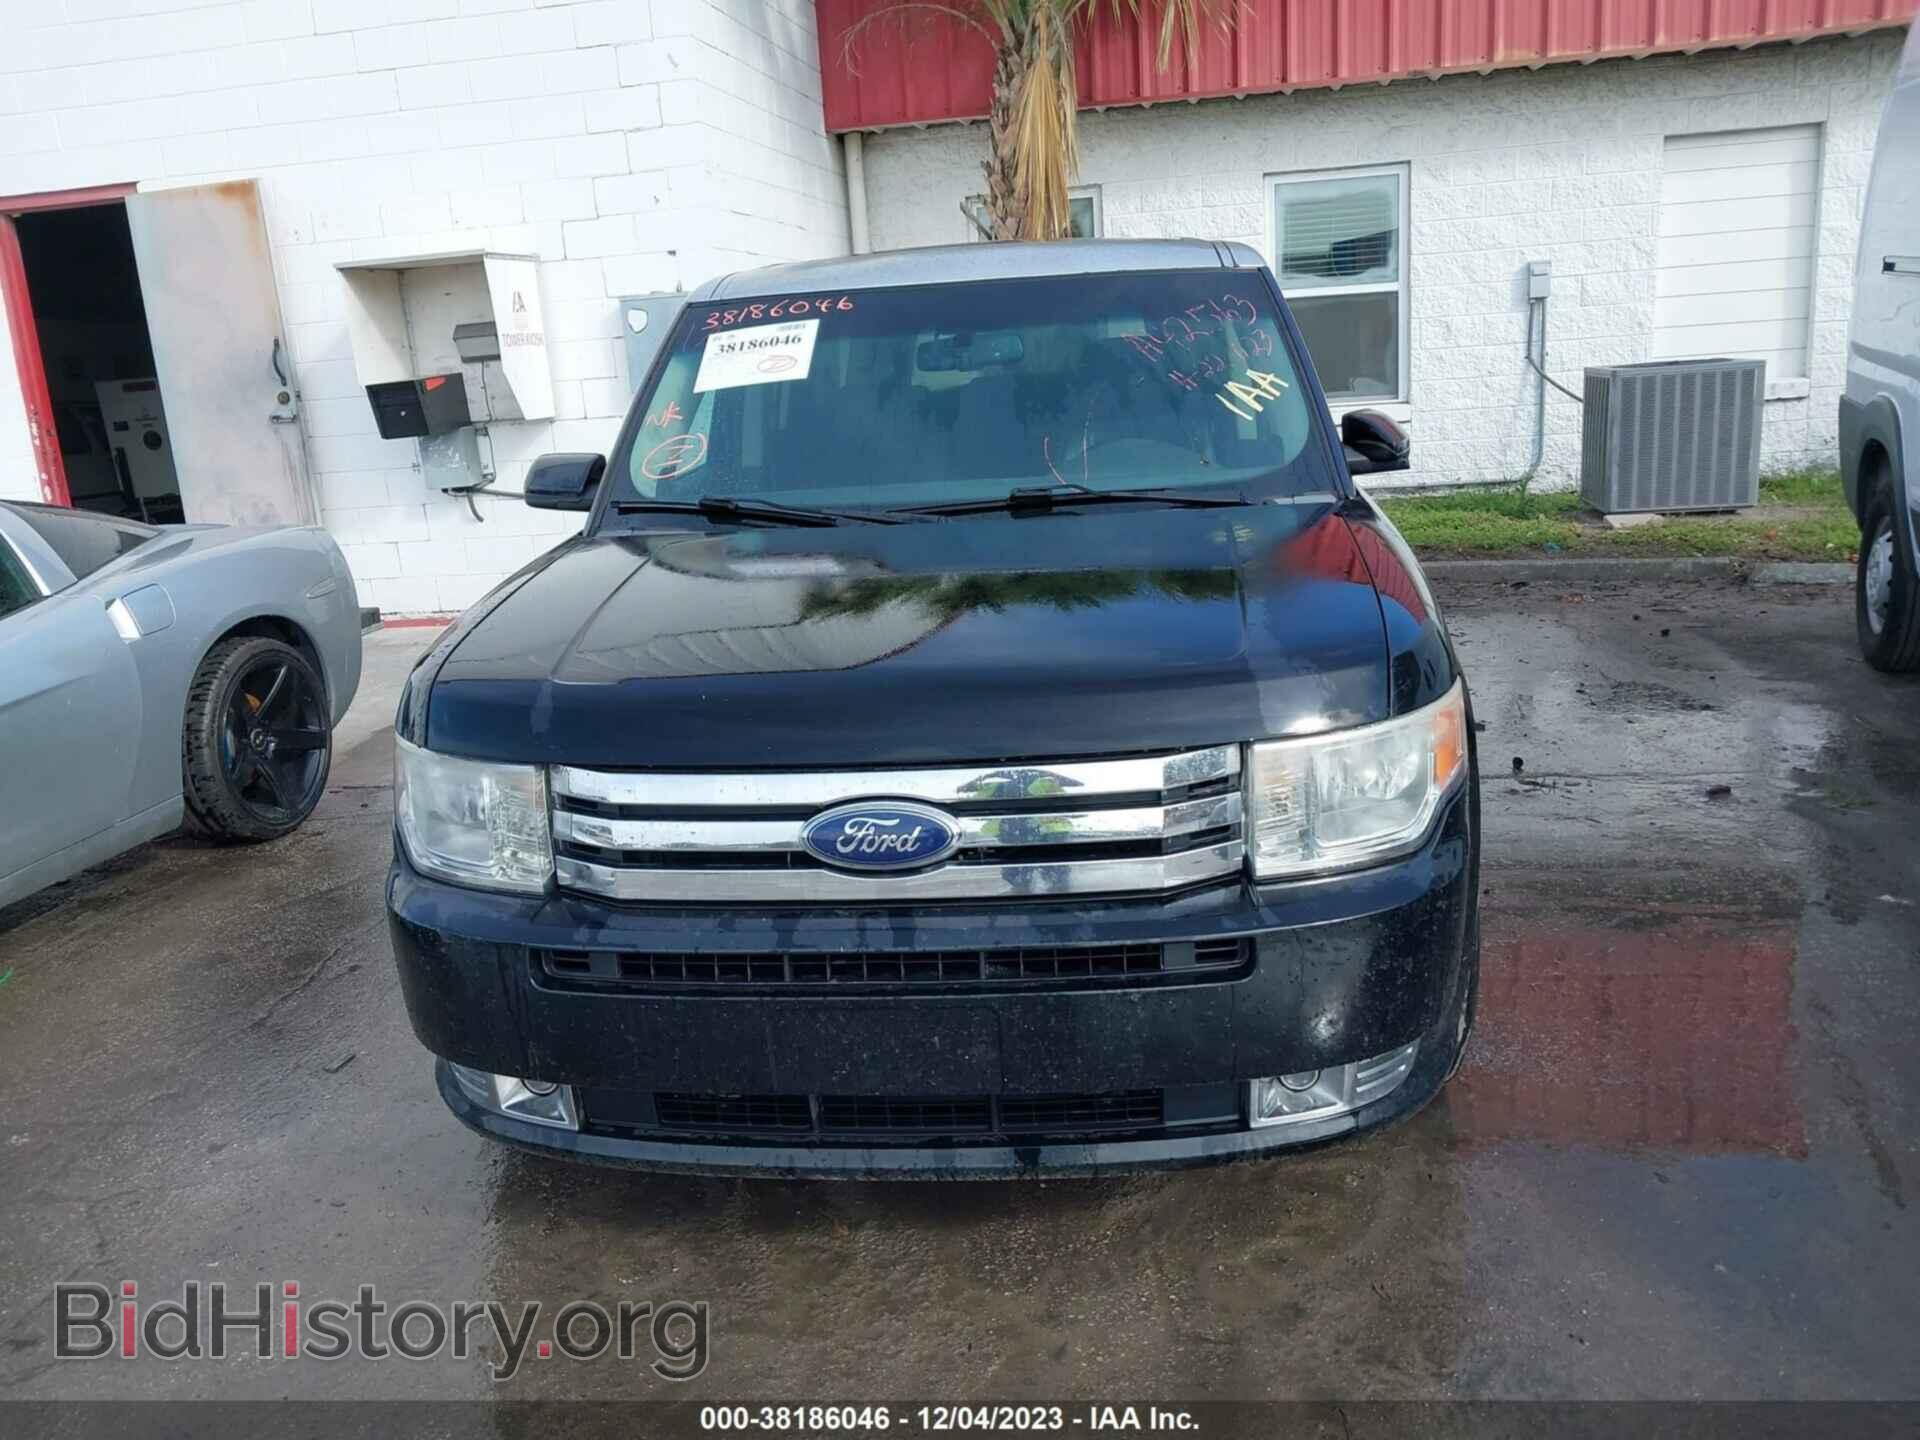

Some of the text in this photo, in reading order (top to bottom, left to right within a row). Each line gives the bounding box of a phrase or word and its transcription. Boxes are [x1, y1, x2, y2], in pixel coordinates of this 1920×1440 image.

[702, 296, 854, 330] 38186046
[718, 334, 803, 355] 38186046
[836, 816, 923, 854] Ford
